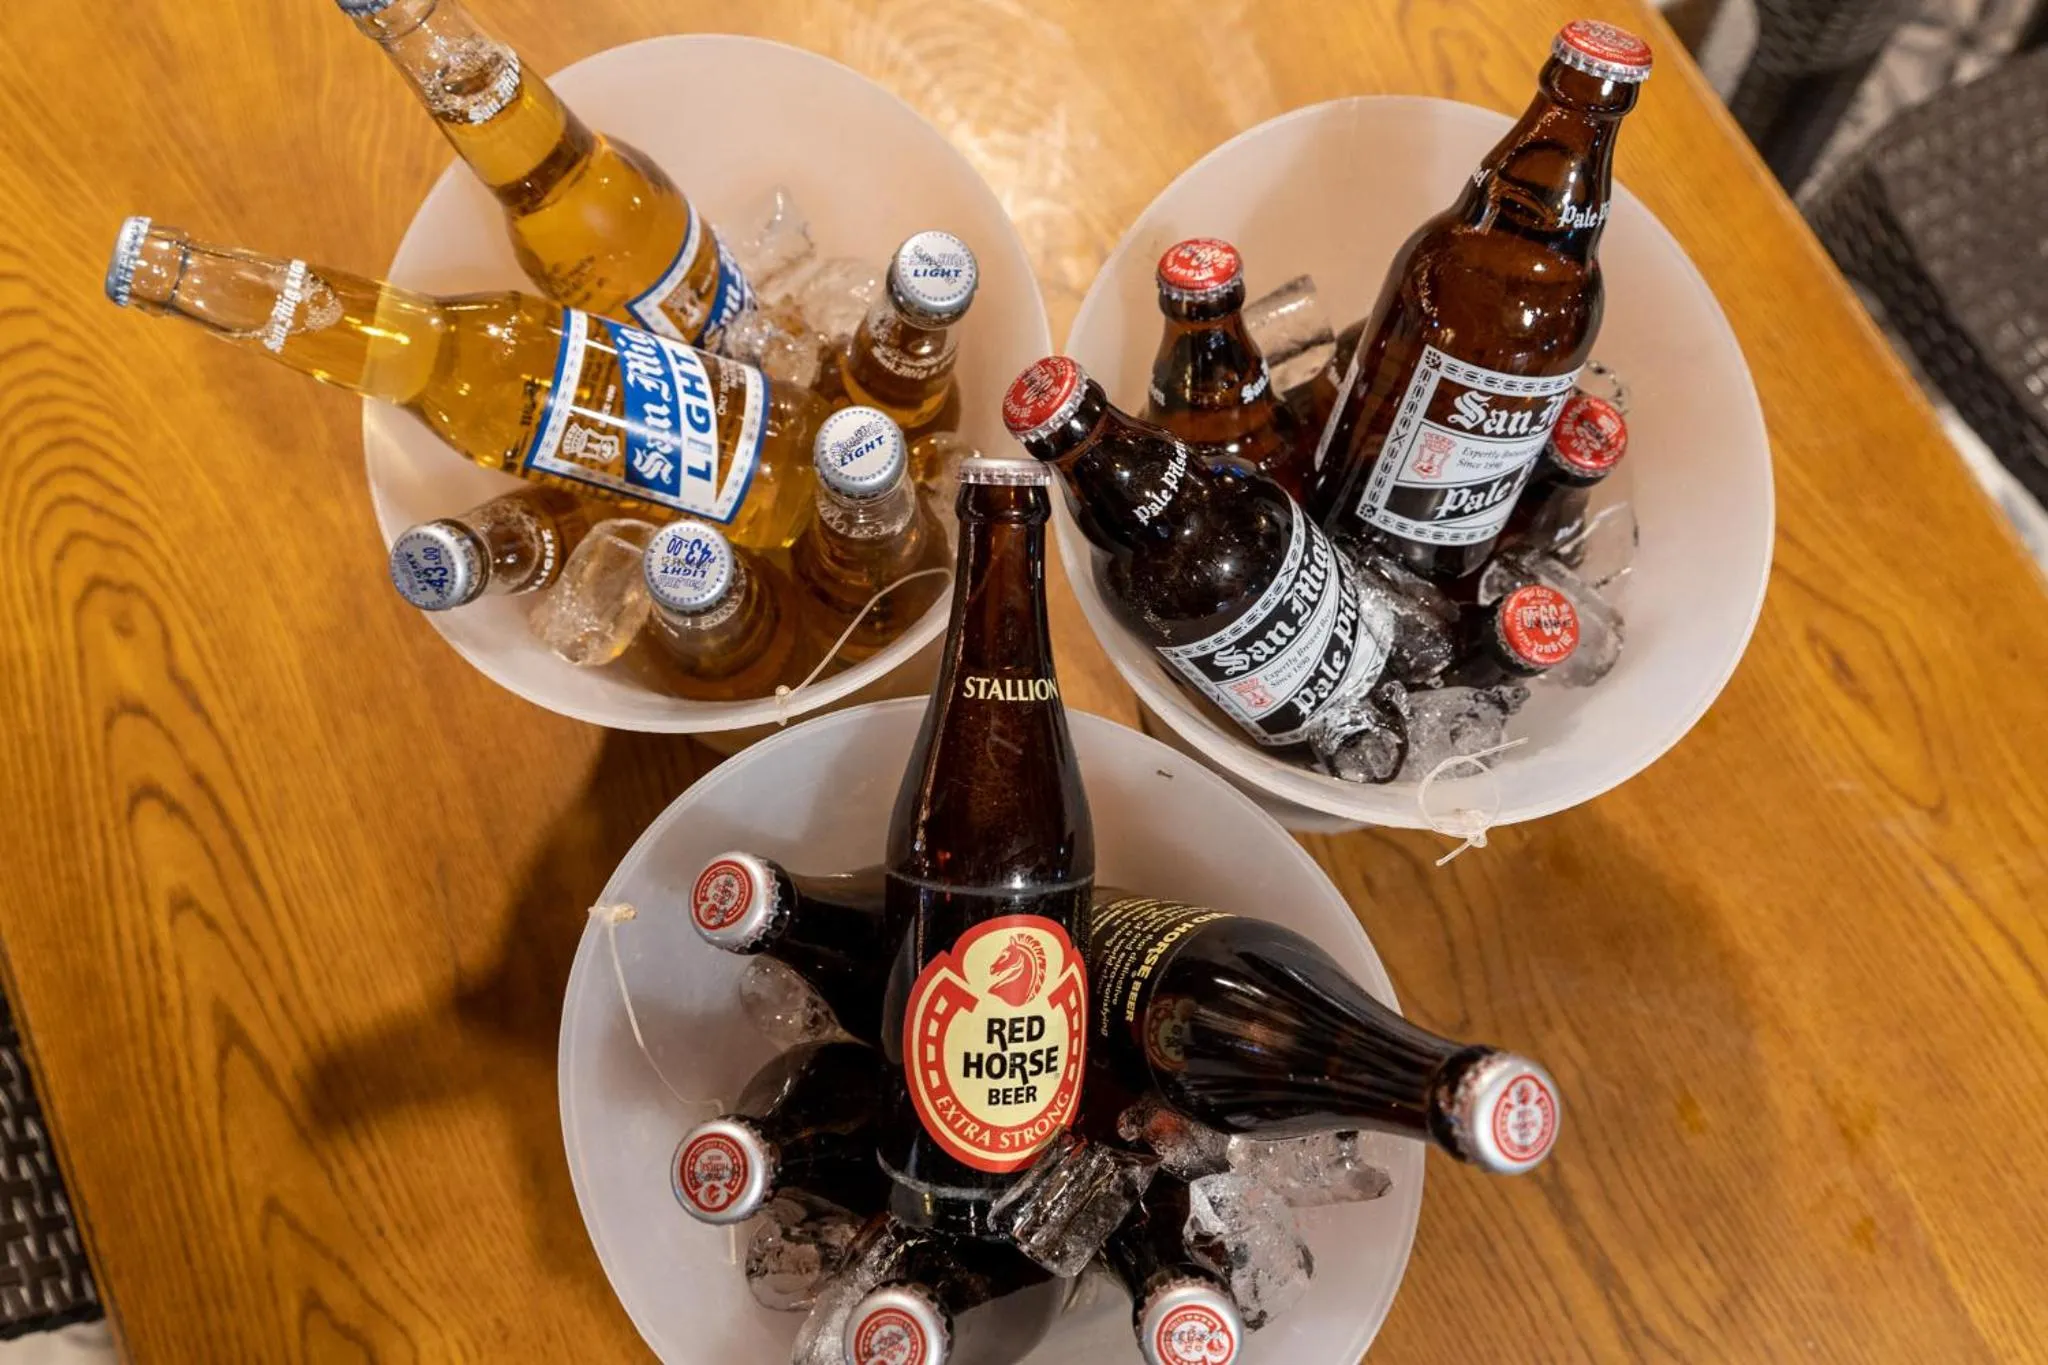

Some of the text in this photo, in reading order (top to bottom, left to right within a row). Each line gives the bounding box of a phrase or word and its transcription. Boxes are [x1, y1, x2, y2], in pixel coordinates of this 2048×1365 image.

[1556, 202, 1597, 229] Pale
[912, 268, 963, 279] LIGHT
[617, 327, 674, 485] San Mig
[671, 348, 713, 483] LIGHT
[1447, 390, 1531, 436] San
[840, 434, 885, 468] LIGHT
[1132, 440, 1189, 527] Pale Pilsen
[1434, 479, 1512, 520] Pale
[406, 551, 428, 592] LIGHT
[534, 529, 554, 586] LIGHT
[660, 566, 707, 579] LIGHT
[1213, 524, 1332, 676] San Migu
[962, 676, 1060, 702] STALLION
[1263, 657, 1299, 682] Expertly
[1291, 650, 1347, 716] Pale
[1137, 922, 1195, 980] HORSE
[1100, 951, 1126, 1037] extra-satisfying
[1112, 952, 1137, 1006] distinctive
[1125, 980, 1142, 1023] BEER
[986, 1014, 1046, 1052] RED
[962, 1045, 1060, 1086] HORSE
[987, 1086, 1038, 1107] BEER
[935, 1090, 1070, 1149] EXTRA STRONG
